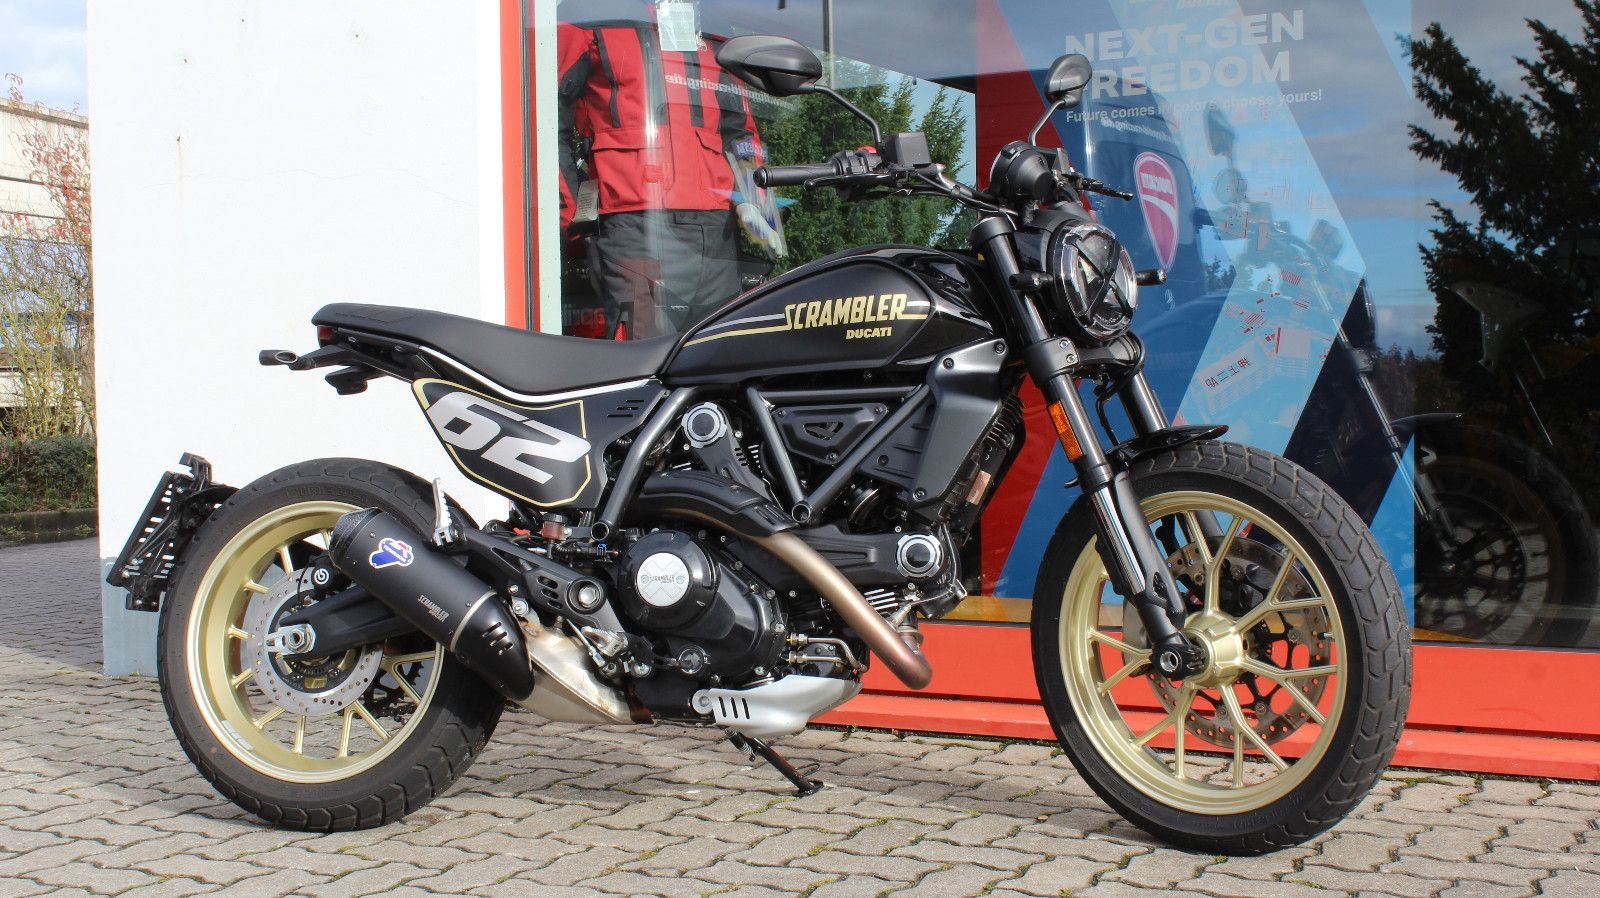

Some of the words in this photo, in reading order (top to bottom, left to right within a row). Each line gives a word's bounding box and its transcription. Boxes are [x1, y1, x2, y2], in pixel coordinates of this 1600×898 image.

[1065, 9, 1304, 63] NEXT-GEN
[1081, 50, 1291, 100] REEDOM
[1066, 108, 1107, 123] Future
[1111, 105, 1155, 118] comes
[1279, 88, 1322, 105] yours!
[784, 293, 908, 331] SCRAMBLER
[845, 326, 893, 340] DUCATI
[426, 391, 592, 485] 62
[417, 594, 450, 619] SCRAMBLER
